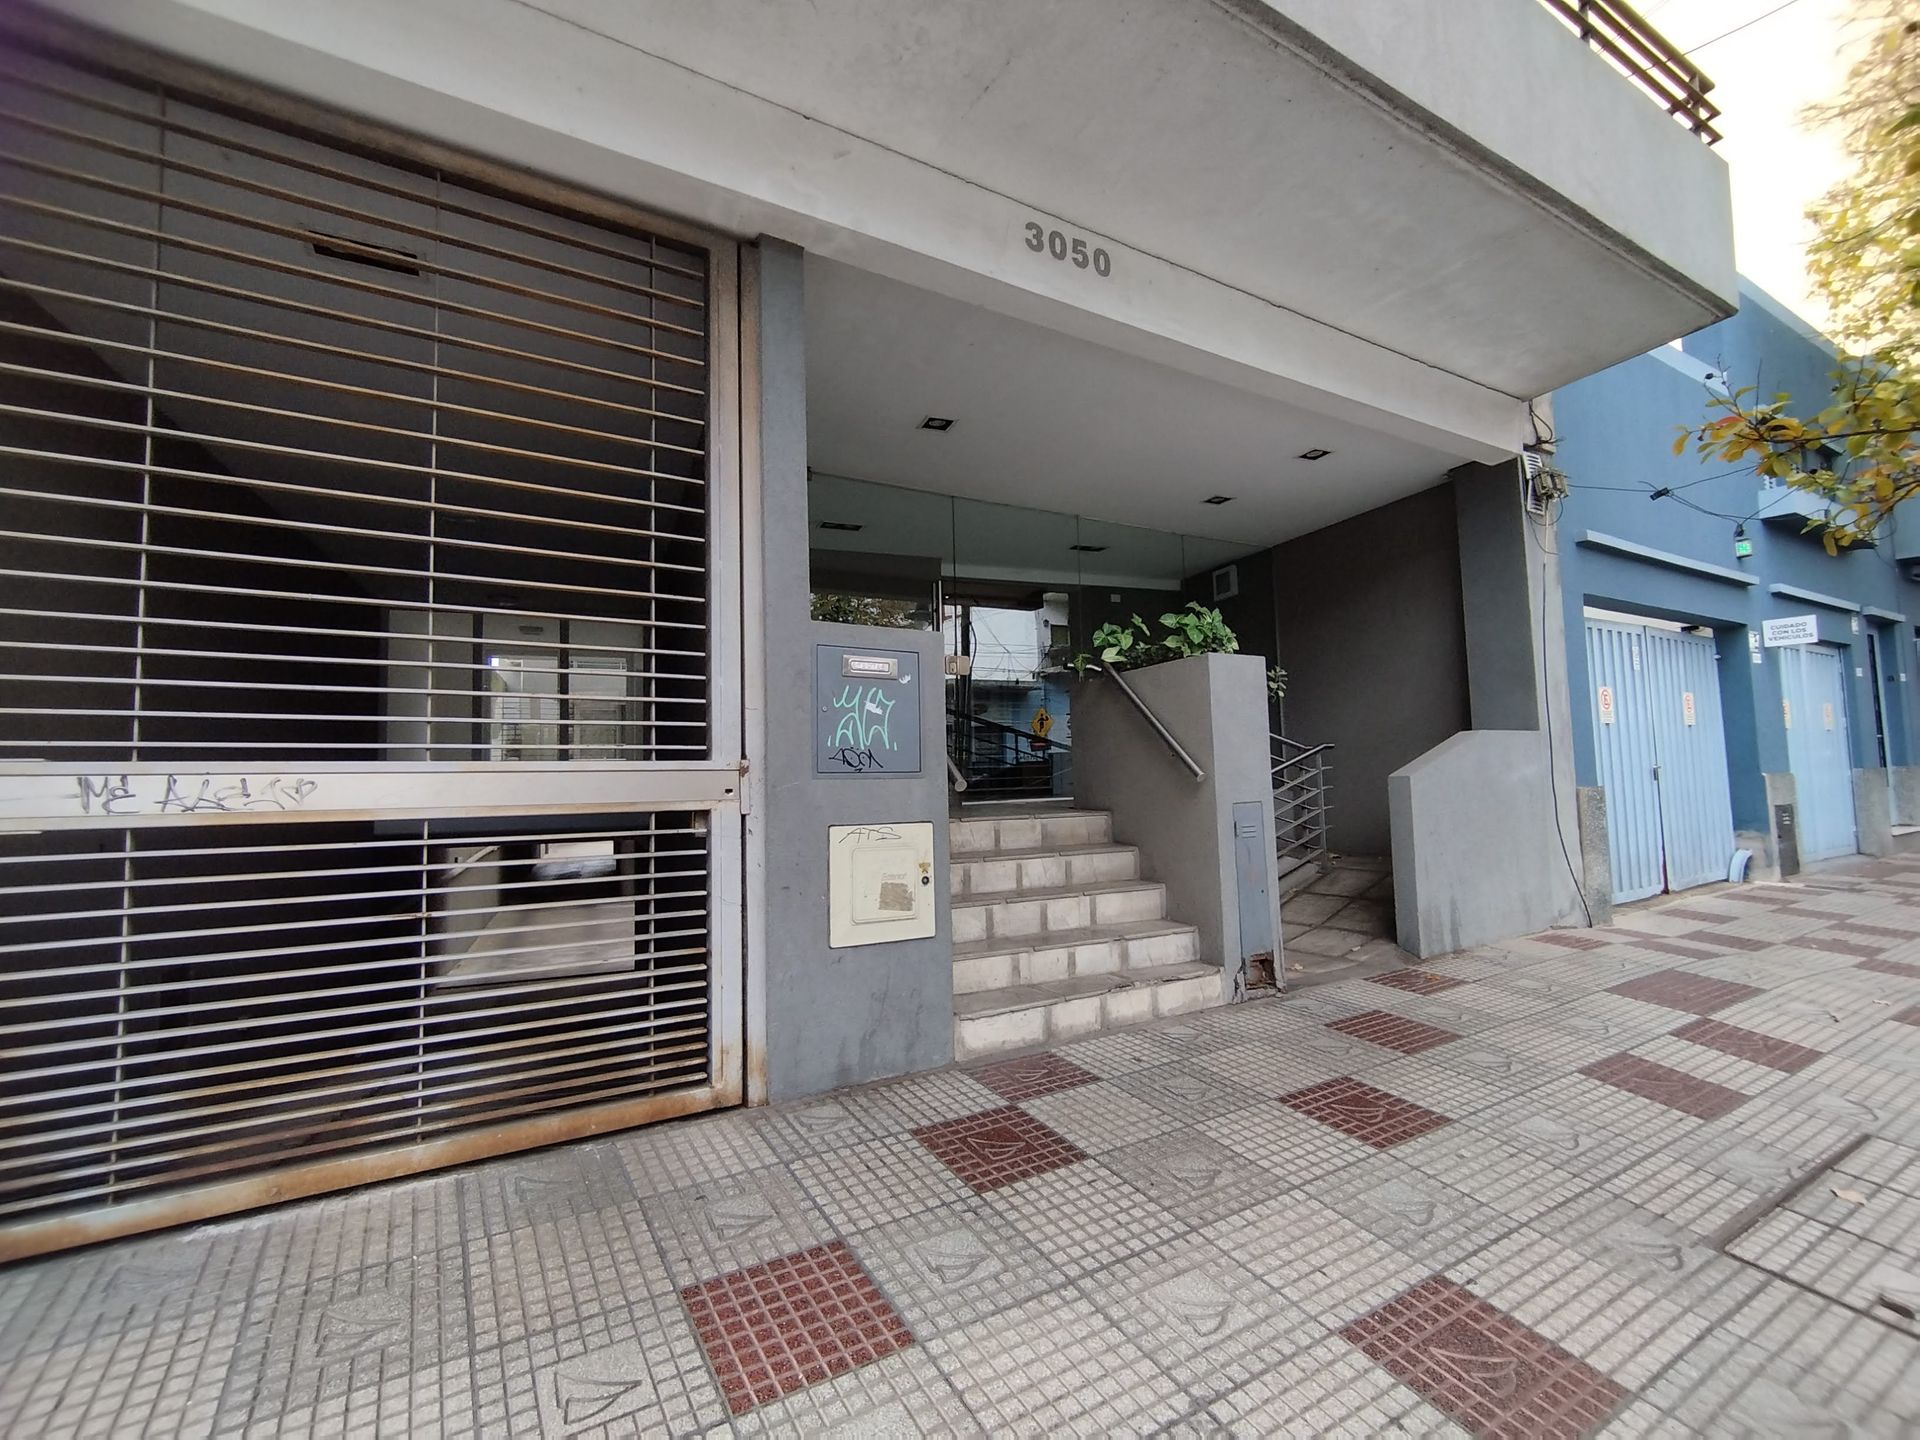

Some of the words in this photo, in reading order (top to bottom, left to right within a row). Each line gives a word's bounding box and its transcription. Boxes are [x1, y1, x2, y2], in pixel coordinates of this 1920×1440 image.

[1025, 221, 1111, 277] 3050
[1770, 621, 1808, 631] CUIDADO
[1768, 632, 1815, 641] VEHICULOS
